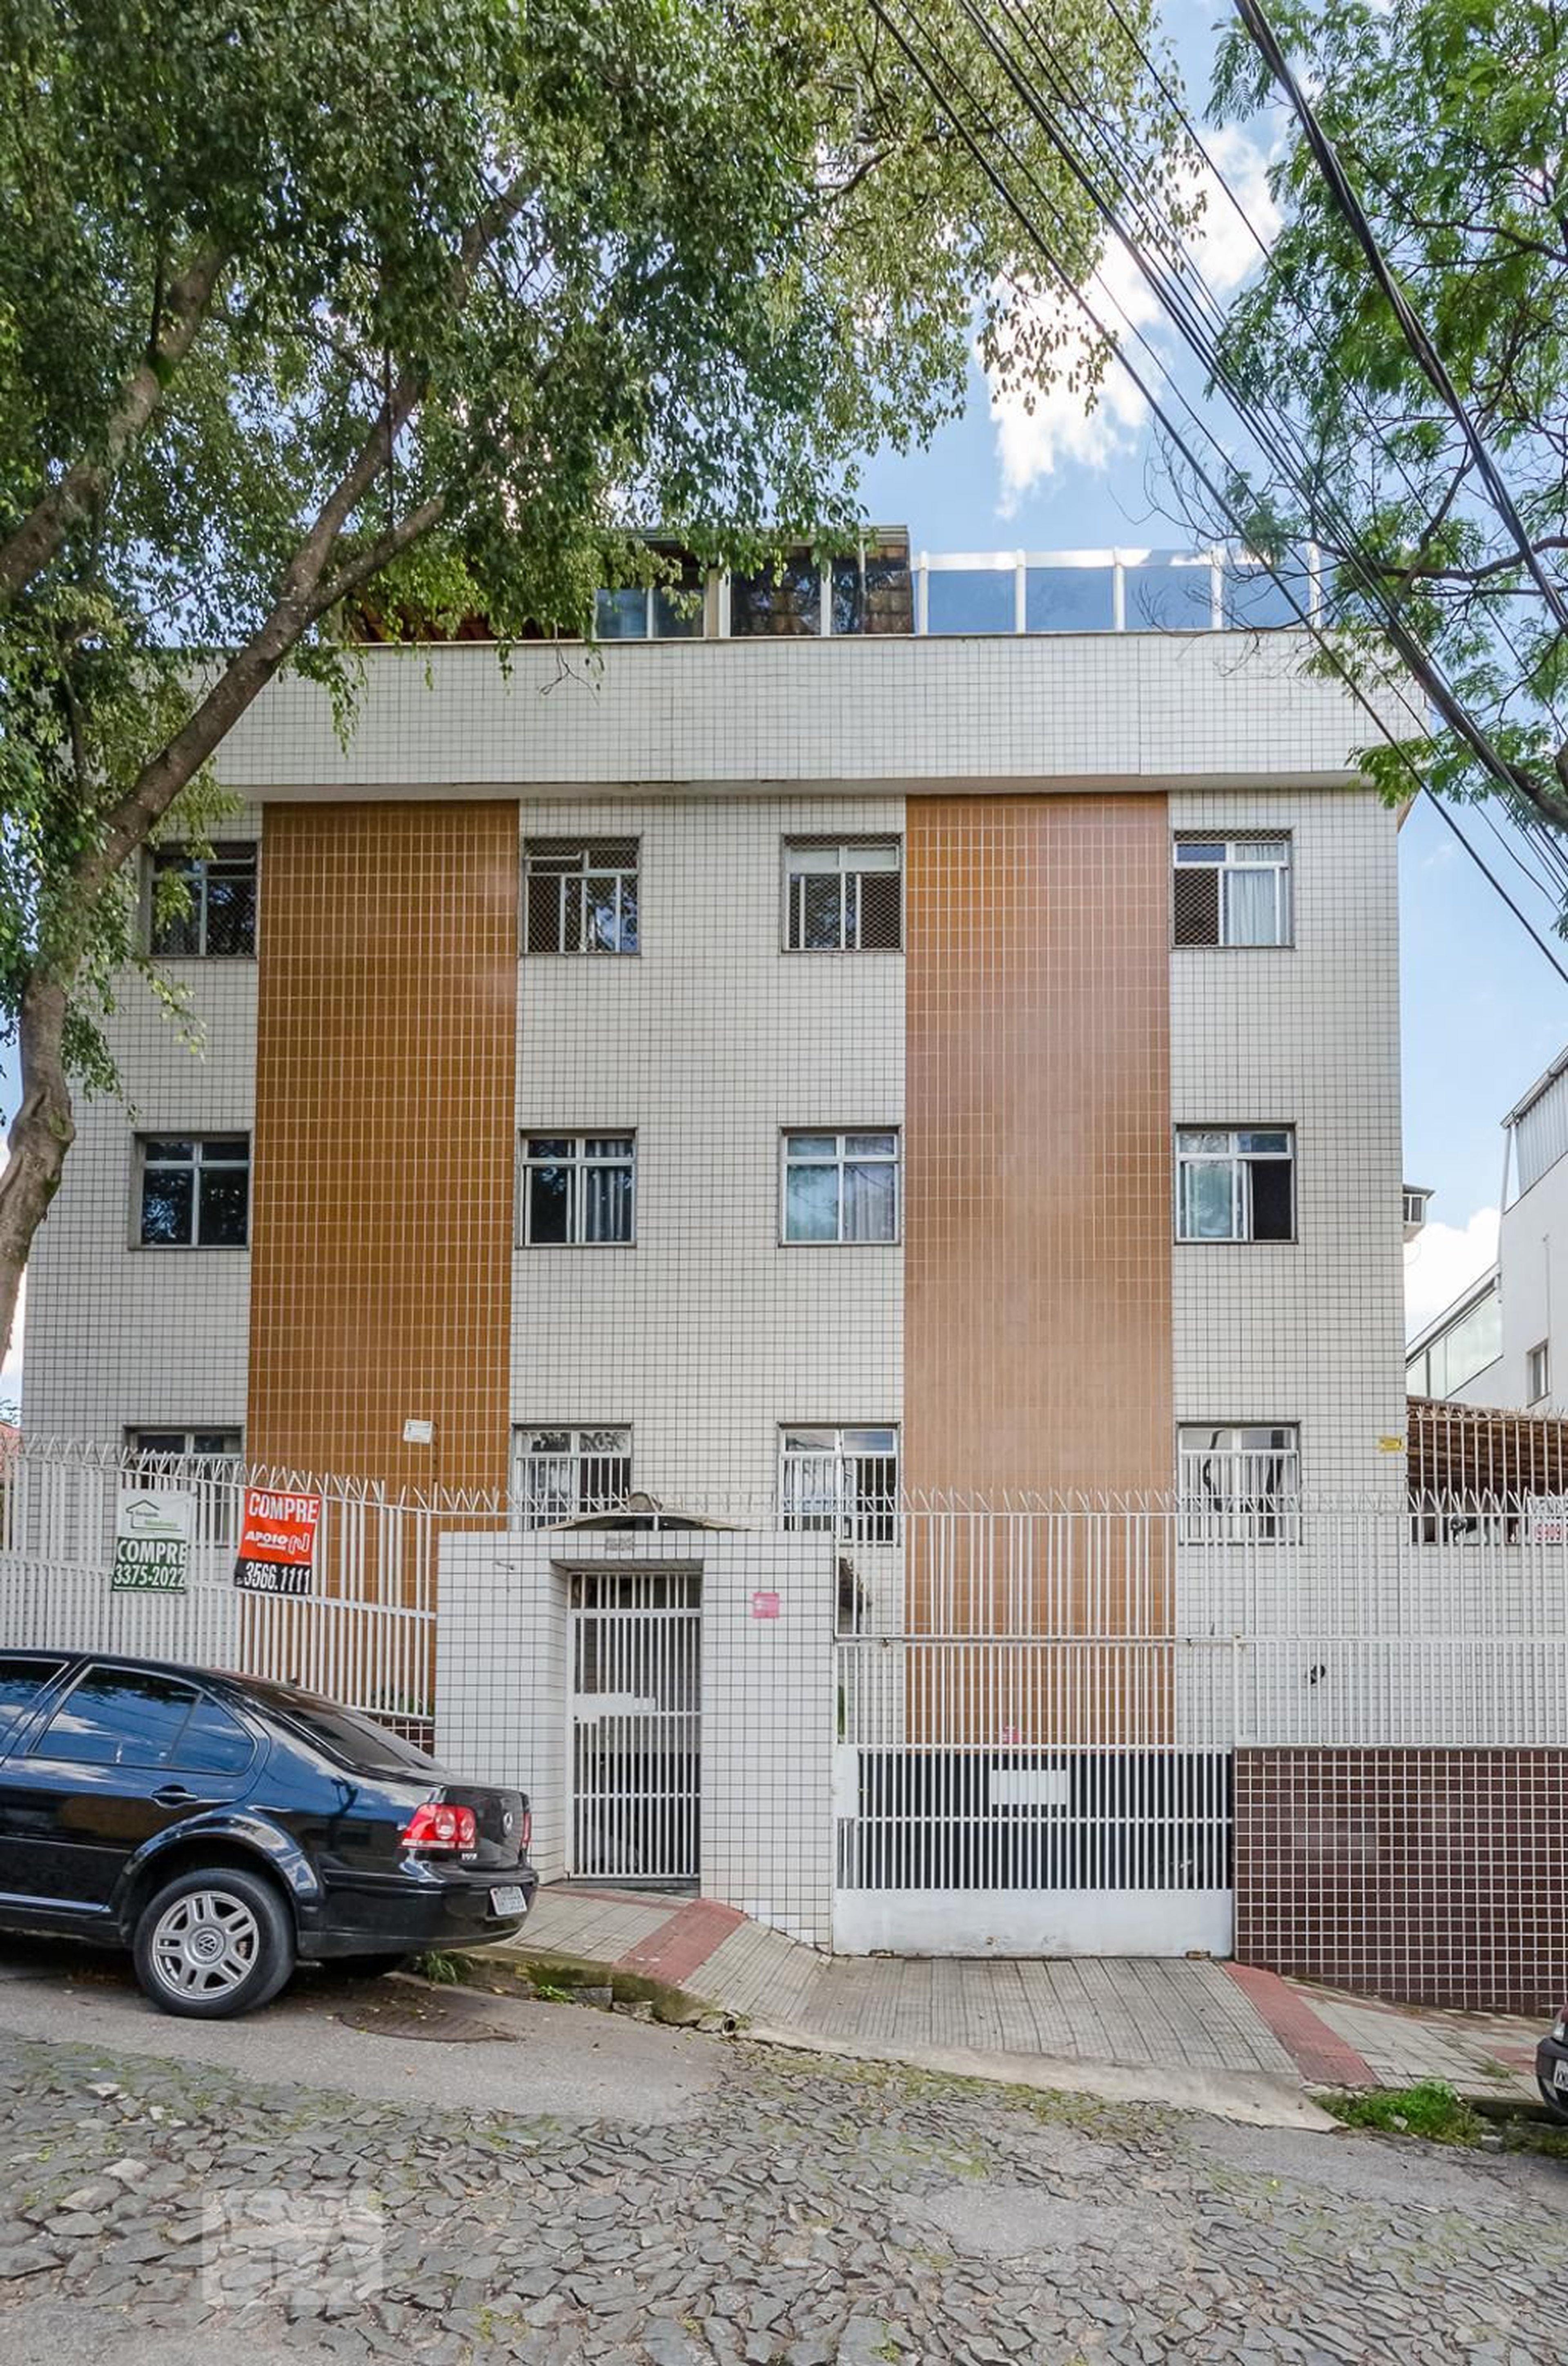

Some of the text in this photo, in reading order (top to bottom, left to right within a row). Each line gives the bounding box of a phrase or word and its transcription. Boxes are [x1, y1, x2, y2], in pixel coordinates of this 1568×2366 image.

[249, 1492, 319, 1524] COMPRE
[245, 1531, 288, 1545] APOIO
[117, 1539, 185, 1565] COMPRE
[114, 1564, 185, 1587] 3375-2022
[244, 1562, 311, 1593] 3566.1111
